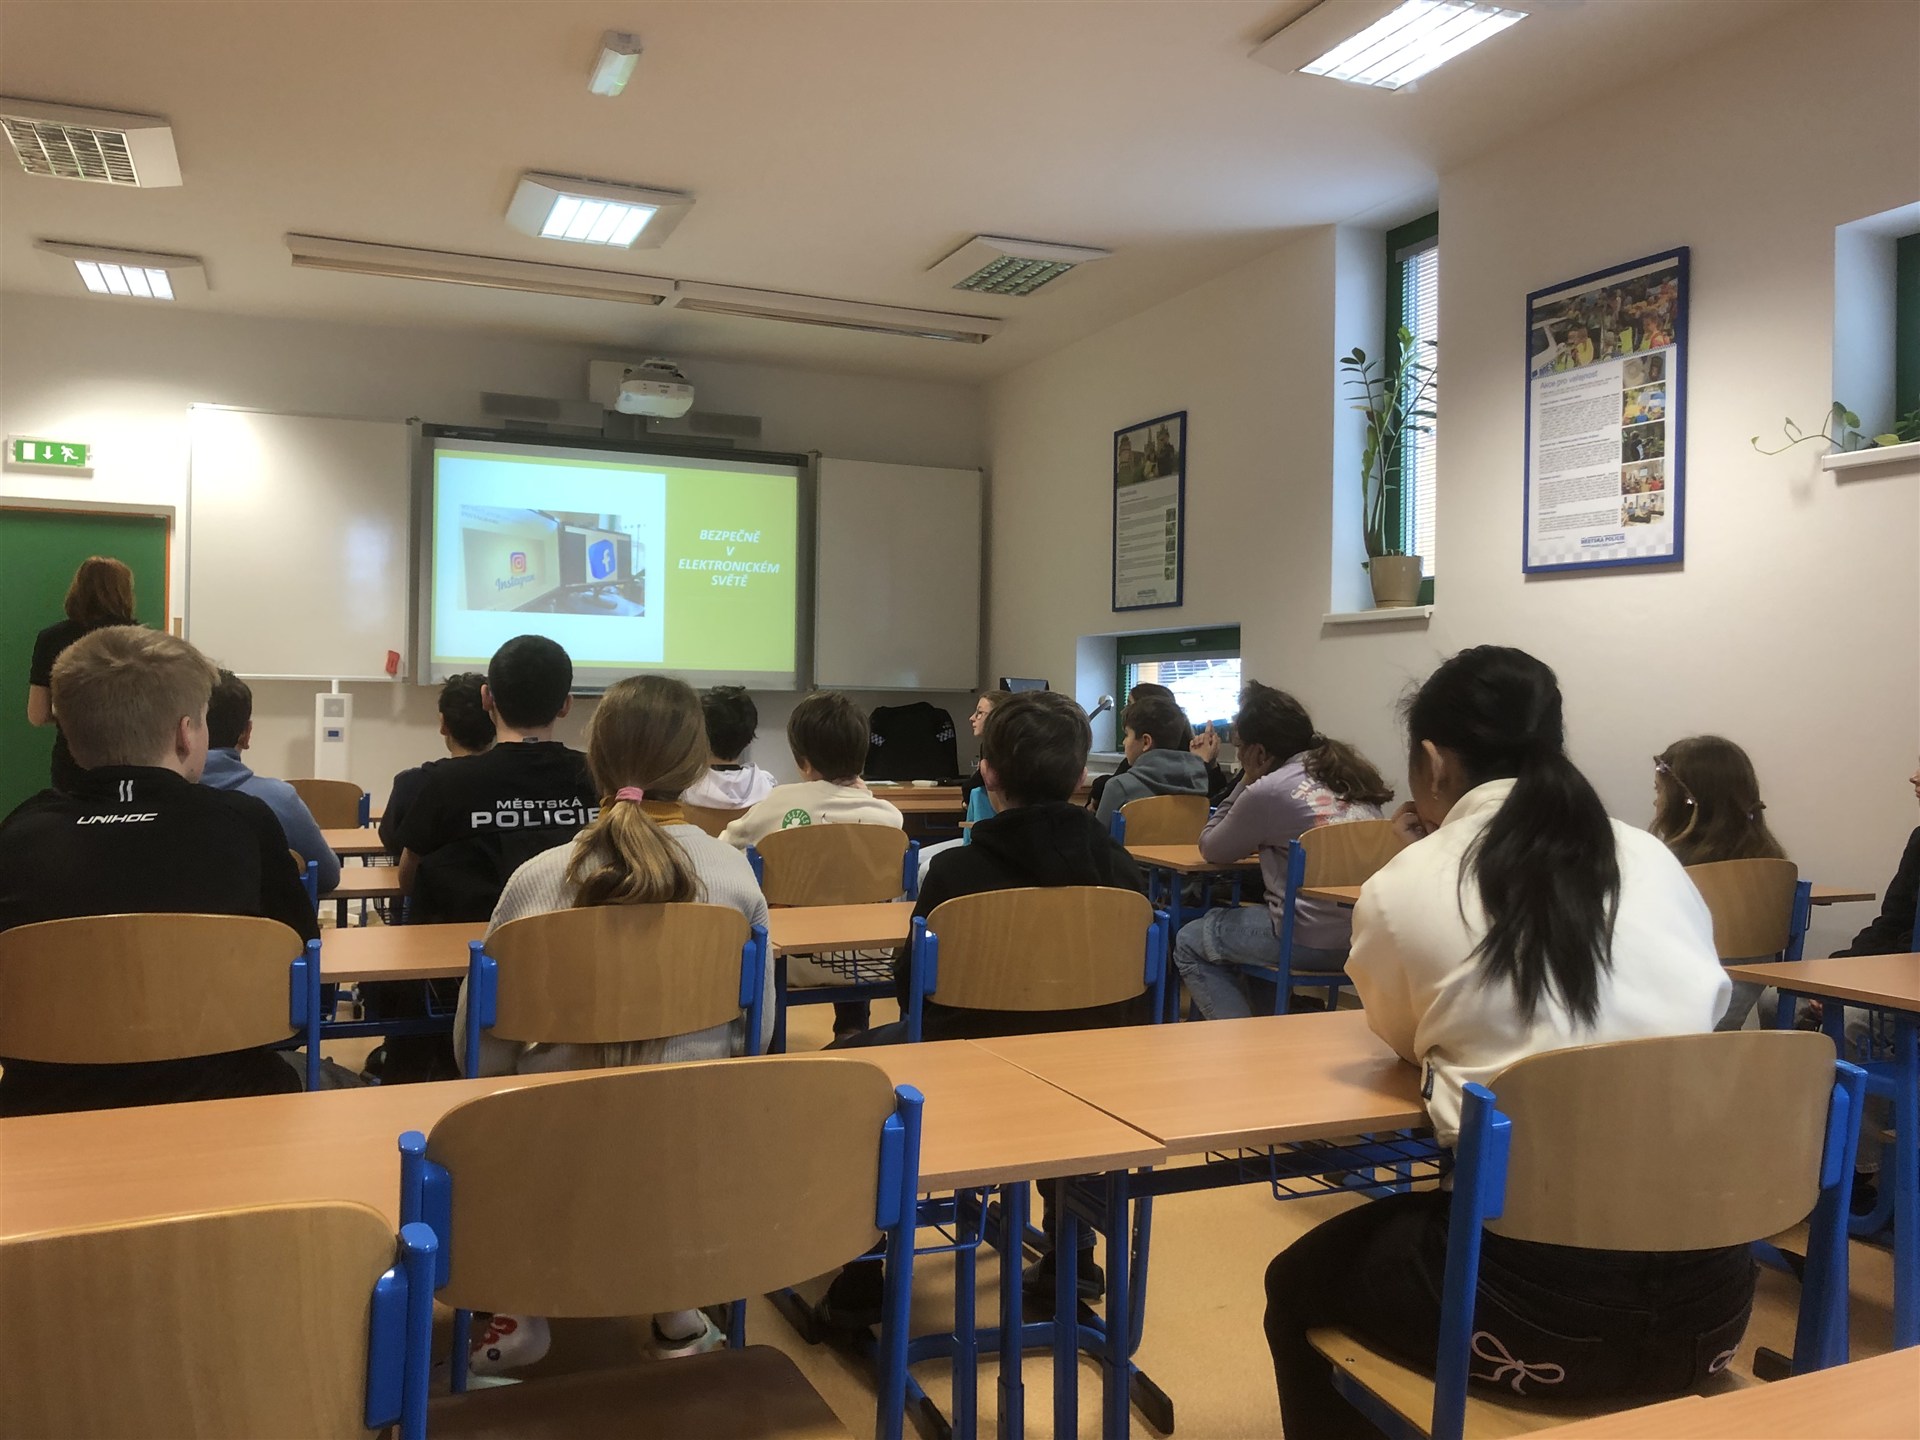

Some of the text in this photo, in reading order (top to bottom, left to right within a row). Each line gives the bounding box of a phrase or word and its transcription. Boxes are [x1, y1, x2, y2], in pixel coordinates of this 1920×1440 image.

[699, 529, 761, 543] BEZPEČNĚ
[678, 558, 780, 574] ELEKTRONICKÉM
[711, 573, 748, 587] SVĚTĚ
[496, 796, 583, 809] MĚSTSKÁ
[76, 813, 158, 825] UNIHOC
[471, 807, 600, 828] POLICIE
[784, 810, 810, 824] CELTICS
